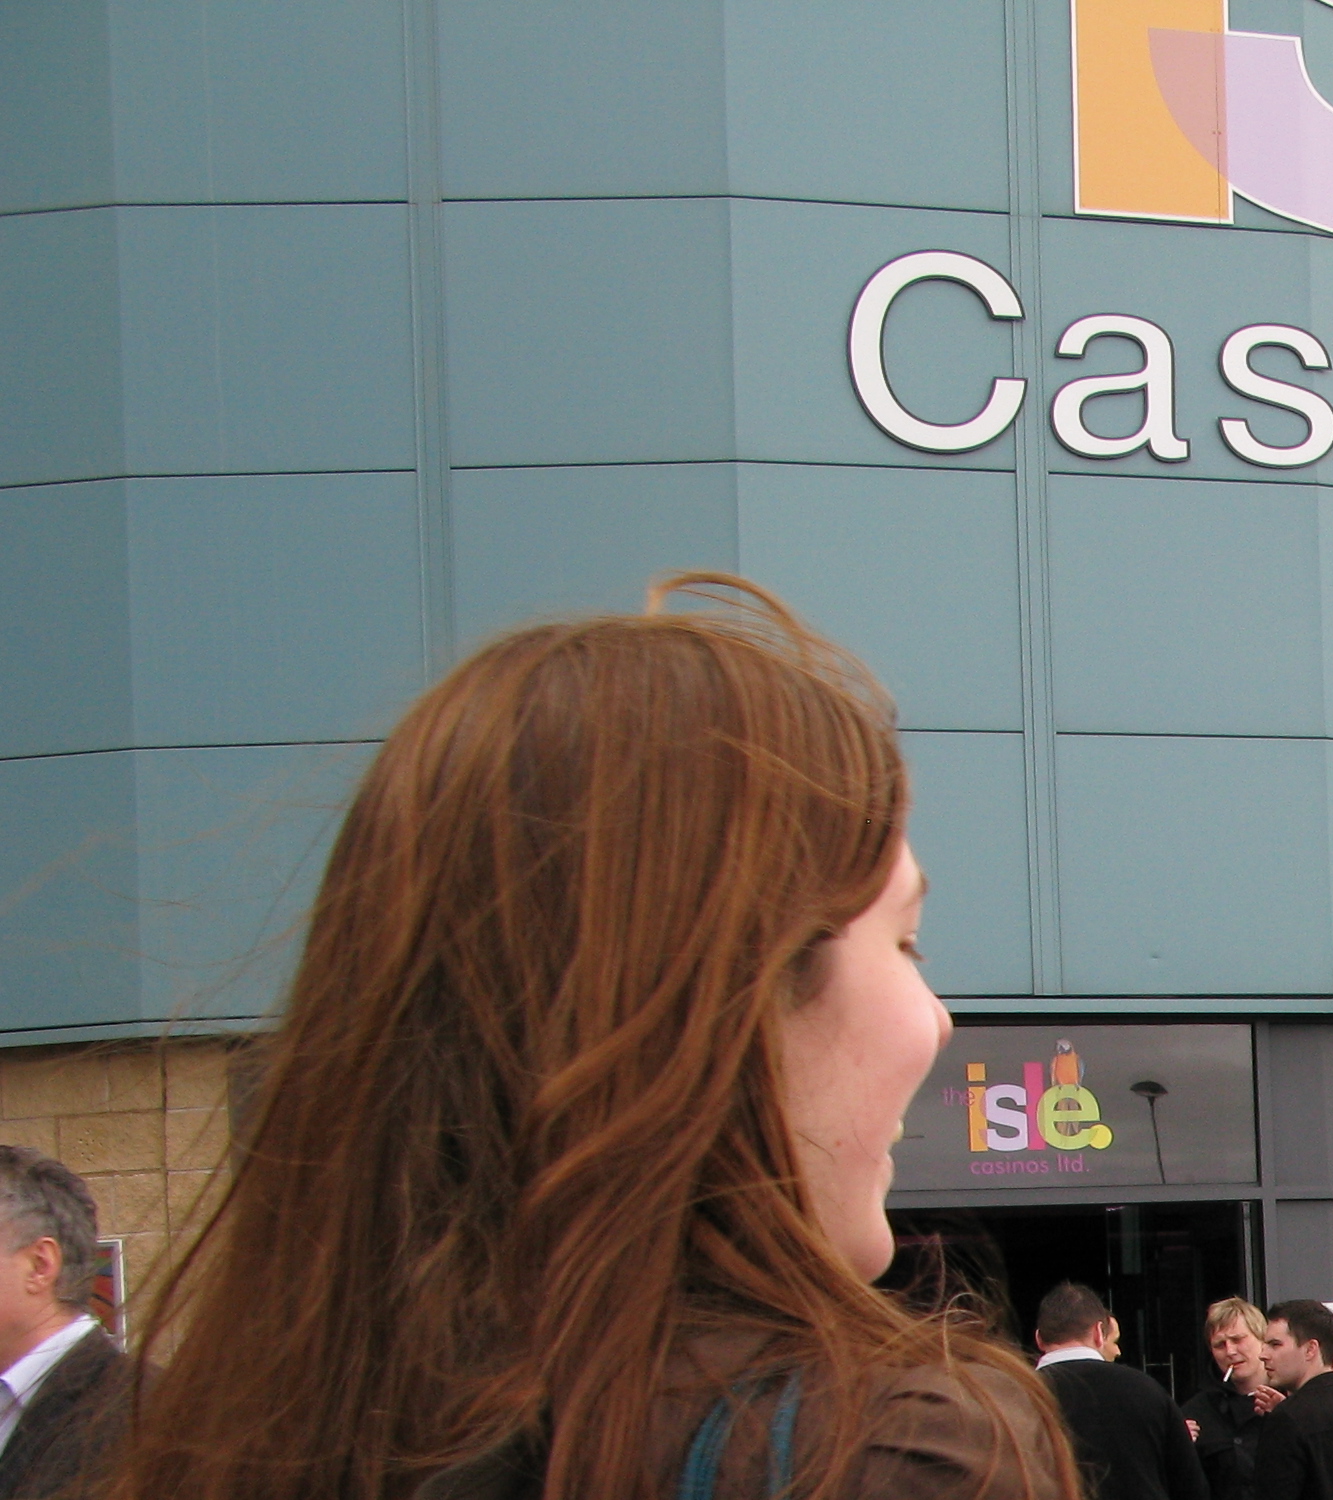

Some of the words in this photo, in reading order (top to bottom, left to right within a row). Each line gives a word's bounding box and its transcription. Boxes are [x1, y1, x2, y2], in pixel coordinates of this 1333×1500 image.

[942, 1086, 975, 1106] the
[967, 1061, 1114, 1152] isle
[969, 1155, 1050, 1175] casinos
[1056, 1153, 1091, 1174] ltd.
